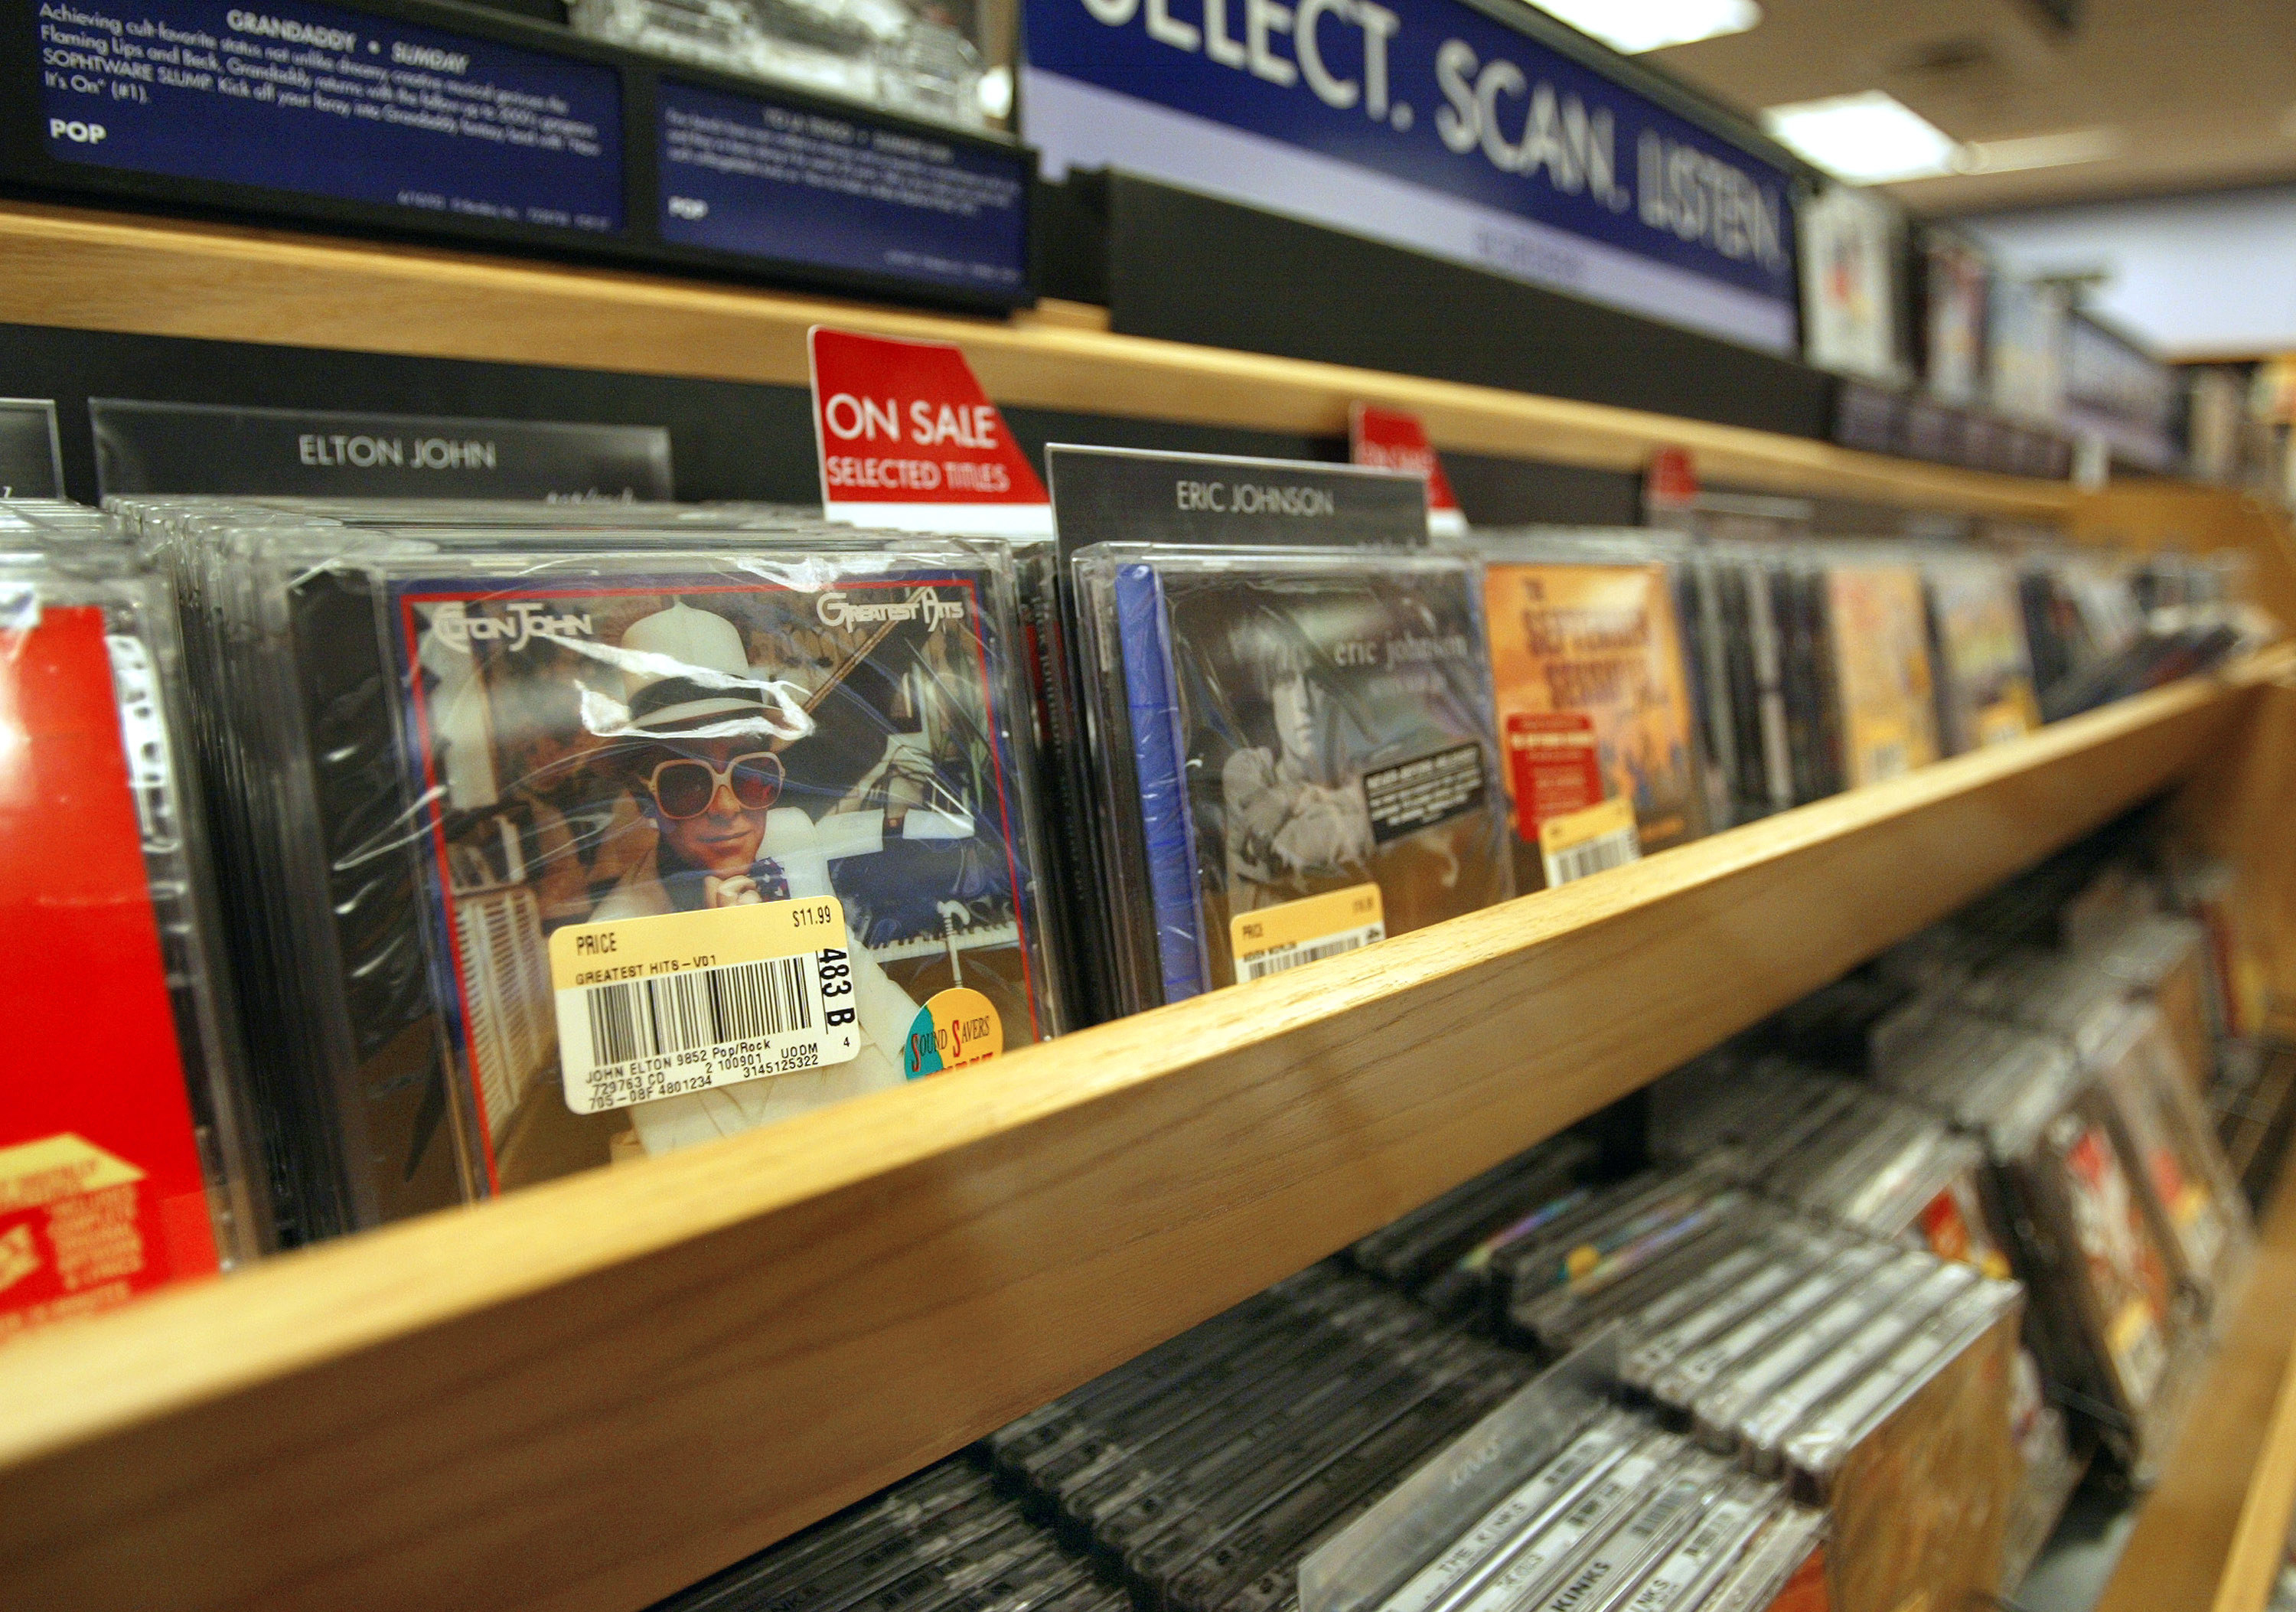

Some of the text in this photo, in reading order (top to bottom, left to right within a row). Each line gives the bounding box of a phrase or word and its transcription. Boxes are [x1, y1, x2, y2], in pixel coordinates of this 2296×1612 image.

[40, 2, 123, 37] Achieving
[227, 8, 357, 54] GRANDADDY
[41, 24, 109, 57] Flaming
[147, 44, 181, 65] and
[49, 118, 107, 145] POP
[1434, 38, 1632, 214] SCAN.
[826, 392, 999, 450] ON SALE
[298, 434, 498, 471] ELTON JOHN
[827, 455, 1012, 493] SELECTED TITLES
[1176, 480, 1336, 519] ERIC JOHNSON
[576, 904, 831, 957] PRICE $11.99
[576, 962, 644, 986] GREATEST
[819, 948, 856, 1027] 483 B
[585, 1039, 771, 1085] JOHN ELTON 9852 Pop/Rock
[843, 1036, 850, 1047] 4
[593, 1076, 643, 1098] 729763
[706, 1062, 713, 1074] 2
[718, 1053, 762, 1072] 100901
[658, 1074, 713, 1096] 4801234
[742, 1053, 819, 1078] 3145125322
[1551, 1560, 1611, 1612] KINKS
